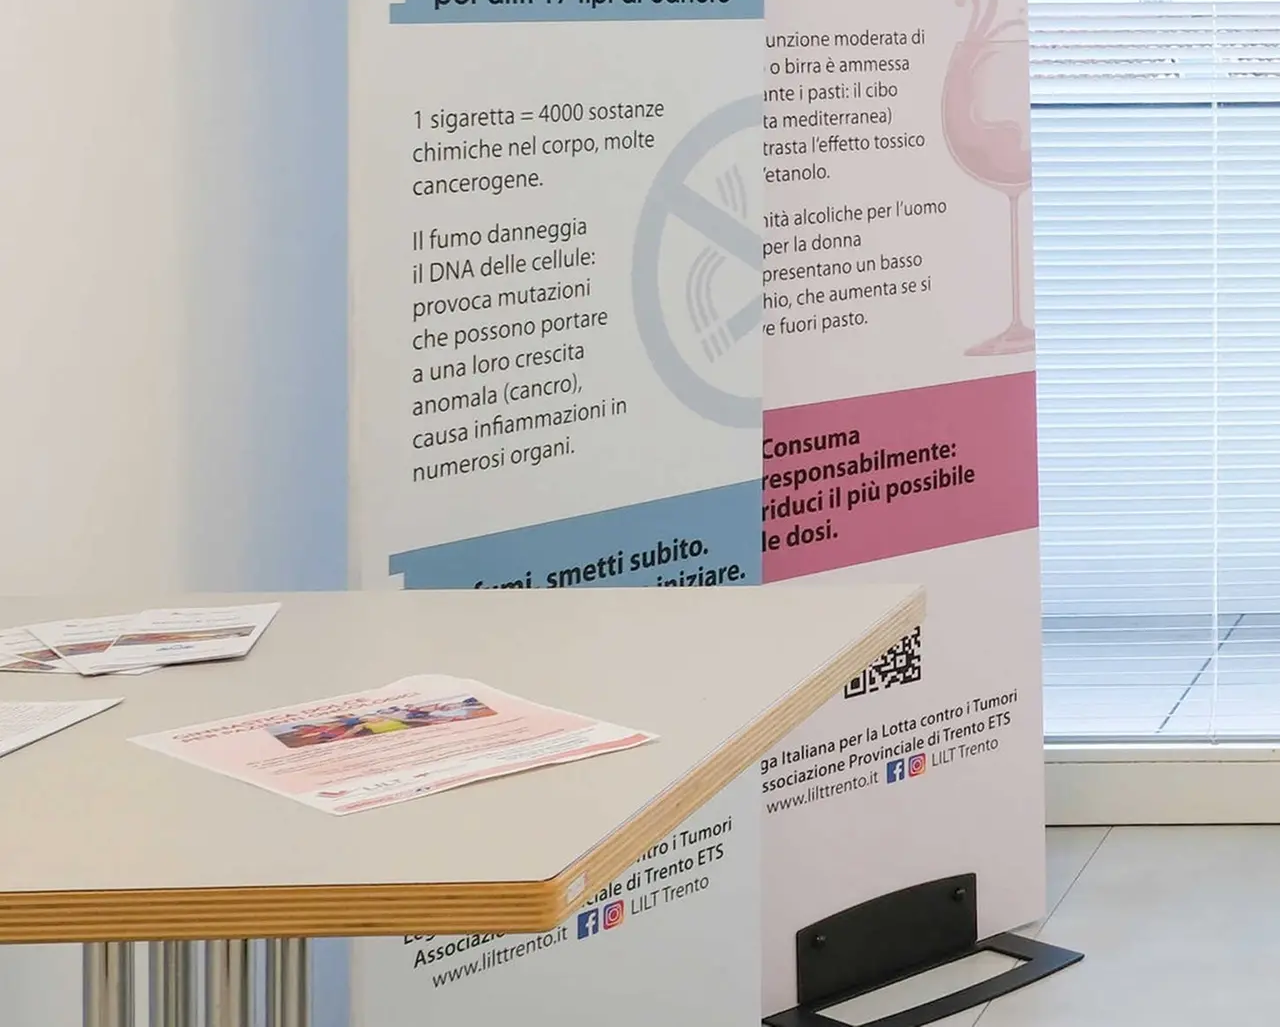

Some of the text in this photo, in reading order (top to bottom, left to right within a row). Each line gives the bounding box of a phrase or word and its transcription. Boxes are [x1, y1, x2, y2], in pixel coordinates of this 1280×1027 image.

[834, 28, 924, 46] moderata di
[770, 57, 909, 75] o birra è ammessa
[808, 81, 898, 104] pasti: il cibo
[414, 102, 664, 133] 1 sigaretta 4000 sostanze
[783, 107, 892, 128] mediterranea)
[413, 130, 654, 162] chimiche nel corpo, molte
[812, 132, 925, 153] l'effetto tossico
[413, 173, 543, 196] cancerogene.
[794, 201, 947, 226] alcoliche per l'uomo
[414, 218, 586, 250] Il fumo danneggia
[763, 234, 861, 259] per la donna
[413, 247, 595, 284] il DNA delle cellule:
[856, 254, 922, 272] un basso
[413, 278, 590, 322] provoca mutazioni
[797, 276, 931, 305] che aumenta se si
[413, 312, 608, 350] che possono portare
[780, 312, 868, 334] fuori pasto.
[413, 343, 584, 383] a una loro crescita
[413, 373, 582, 416] anomala (cancro),
[413, 398, 626, 449] causa infiammazioni in
[413, 436, 574, 482] numerosi organi.
[763, 430, 860, 459] Consuma
[763, 443, 956, 491] responsabilmente:
[763, 465, 975, 521] riduci il più possibile
[763, 519, 838, 552] le dosi.
[546, 550, 623, 588] smetti
[630, 538, 708, 571] subito.
[782, 688, 1017, 765] Italiana per la Lotta contro Tumori
[849, 711, 1010, 769] Provinciale di Trento ETS
[932, 739, 998, 766] LILT Trento
[766, 771, 879, 814] www.lilttrento.it
[679, 816, 731, 847] Tumori
[626, 843, 724, 891] di Trento ETS
[630, 890, 658, 916] LILT
[661, 875, 710, 904] Trento
[432, 927, 568, 988] www.lilttrento.it
